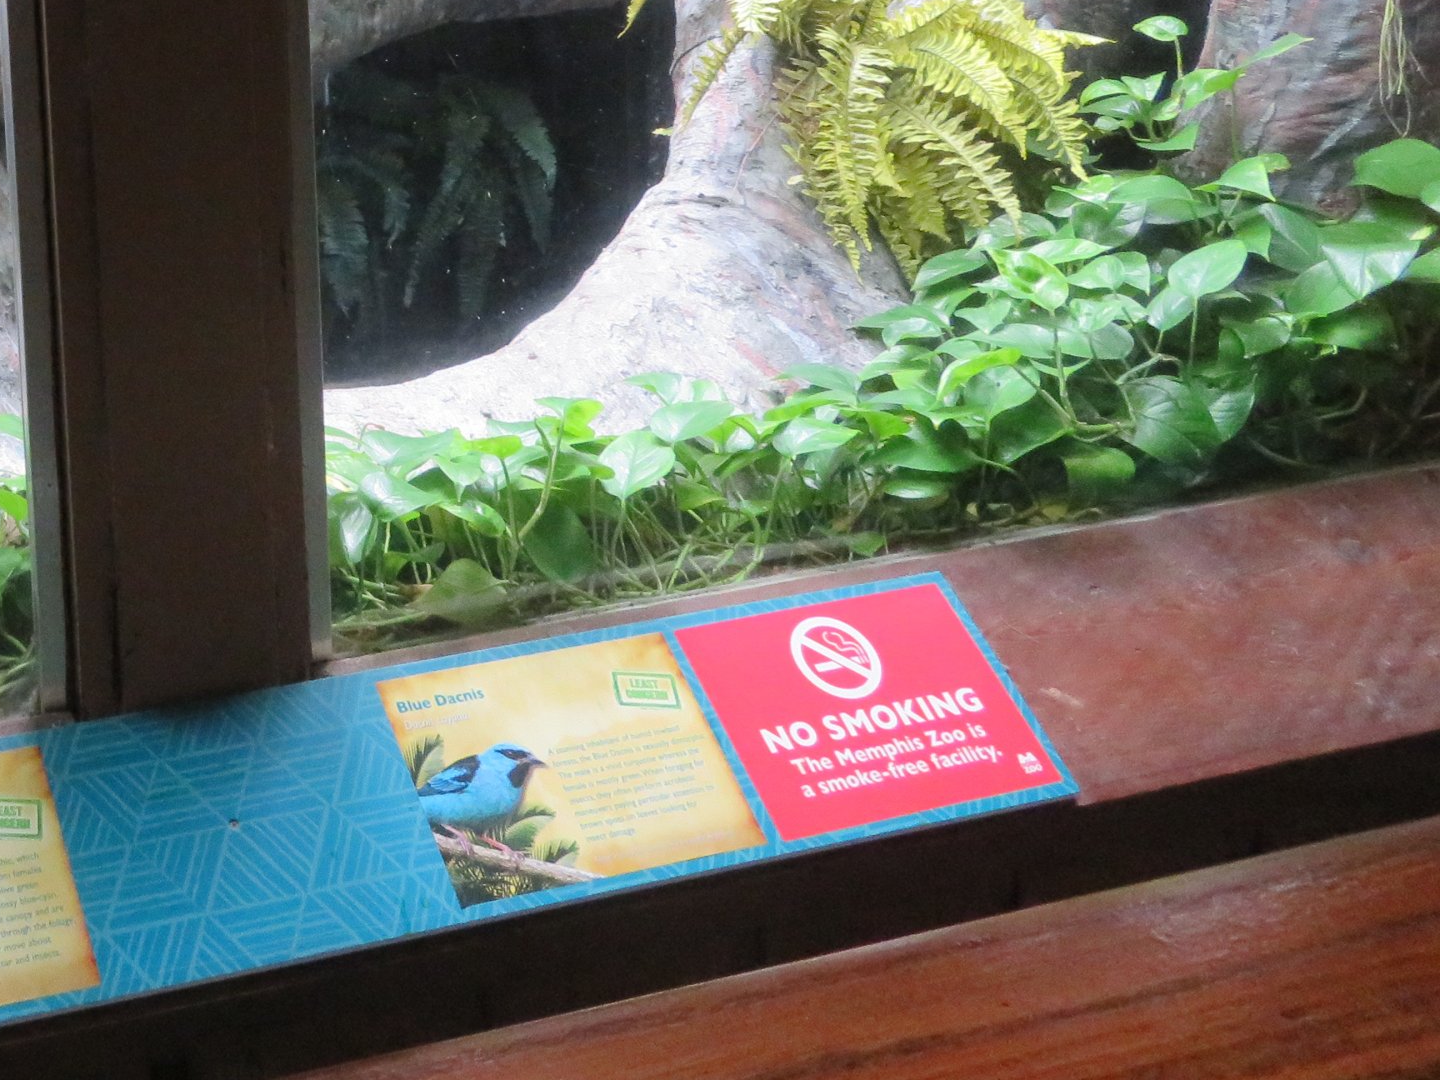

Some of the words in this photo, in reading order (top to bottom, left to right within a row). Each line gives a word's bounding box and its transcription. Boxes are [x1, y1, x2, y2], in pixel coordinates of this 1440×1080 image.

[396, 701, 431, 713] Blue
[434, 689, 484, 706] Dacnis
[759, 720, 818, 754] NO
[822, 687, 984, 741] SMOKING
[791, 756, 833, 776] The
[837, 736, 924, 767] Memphis
[929, 728, 965, 748] Zoo
[968, 723, 986, 739] is
[801, 783, 815, 799] a
[818, 759, 929, 795] smoke-free
[932, 745, 1003, 771] facility.
